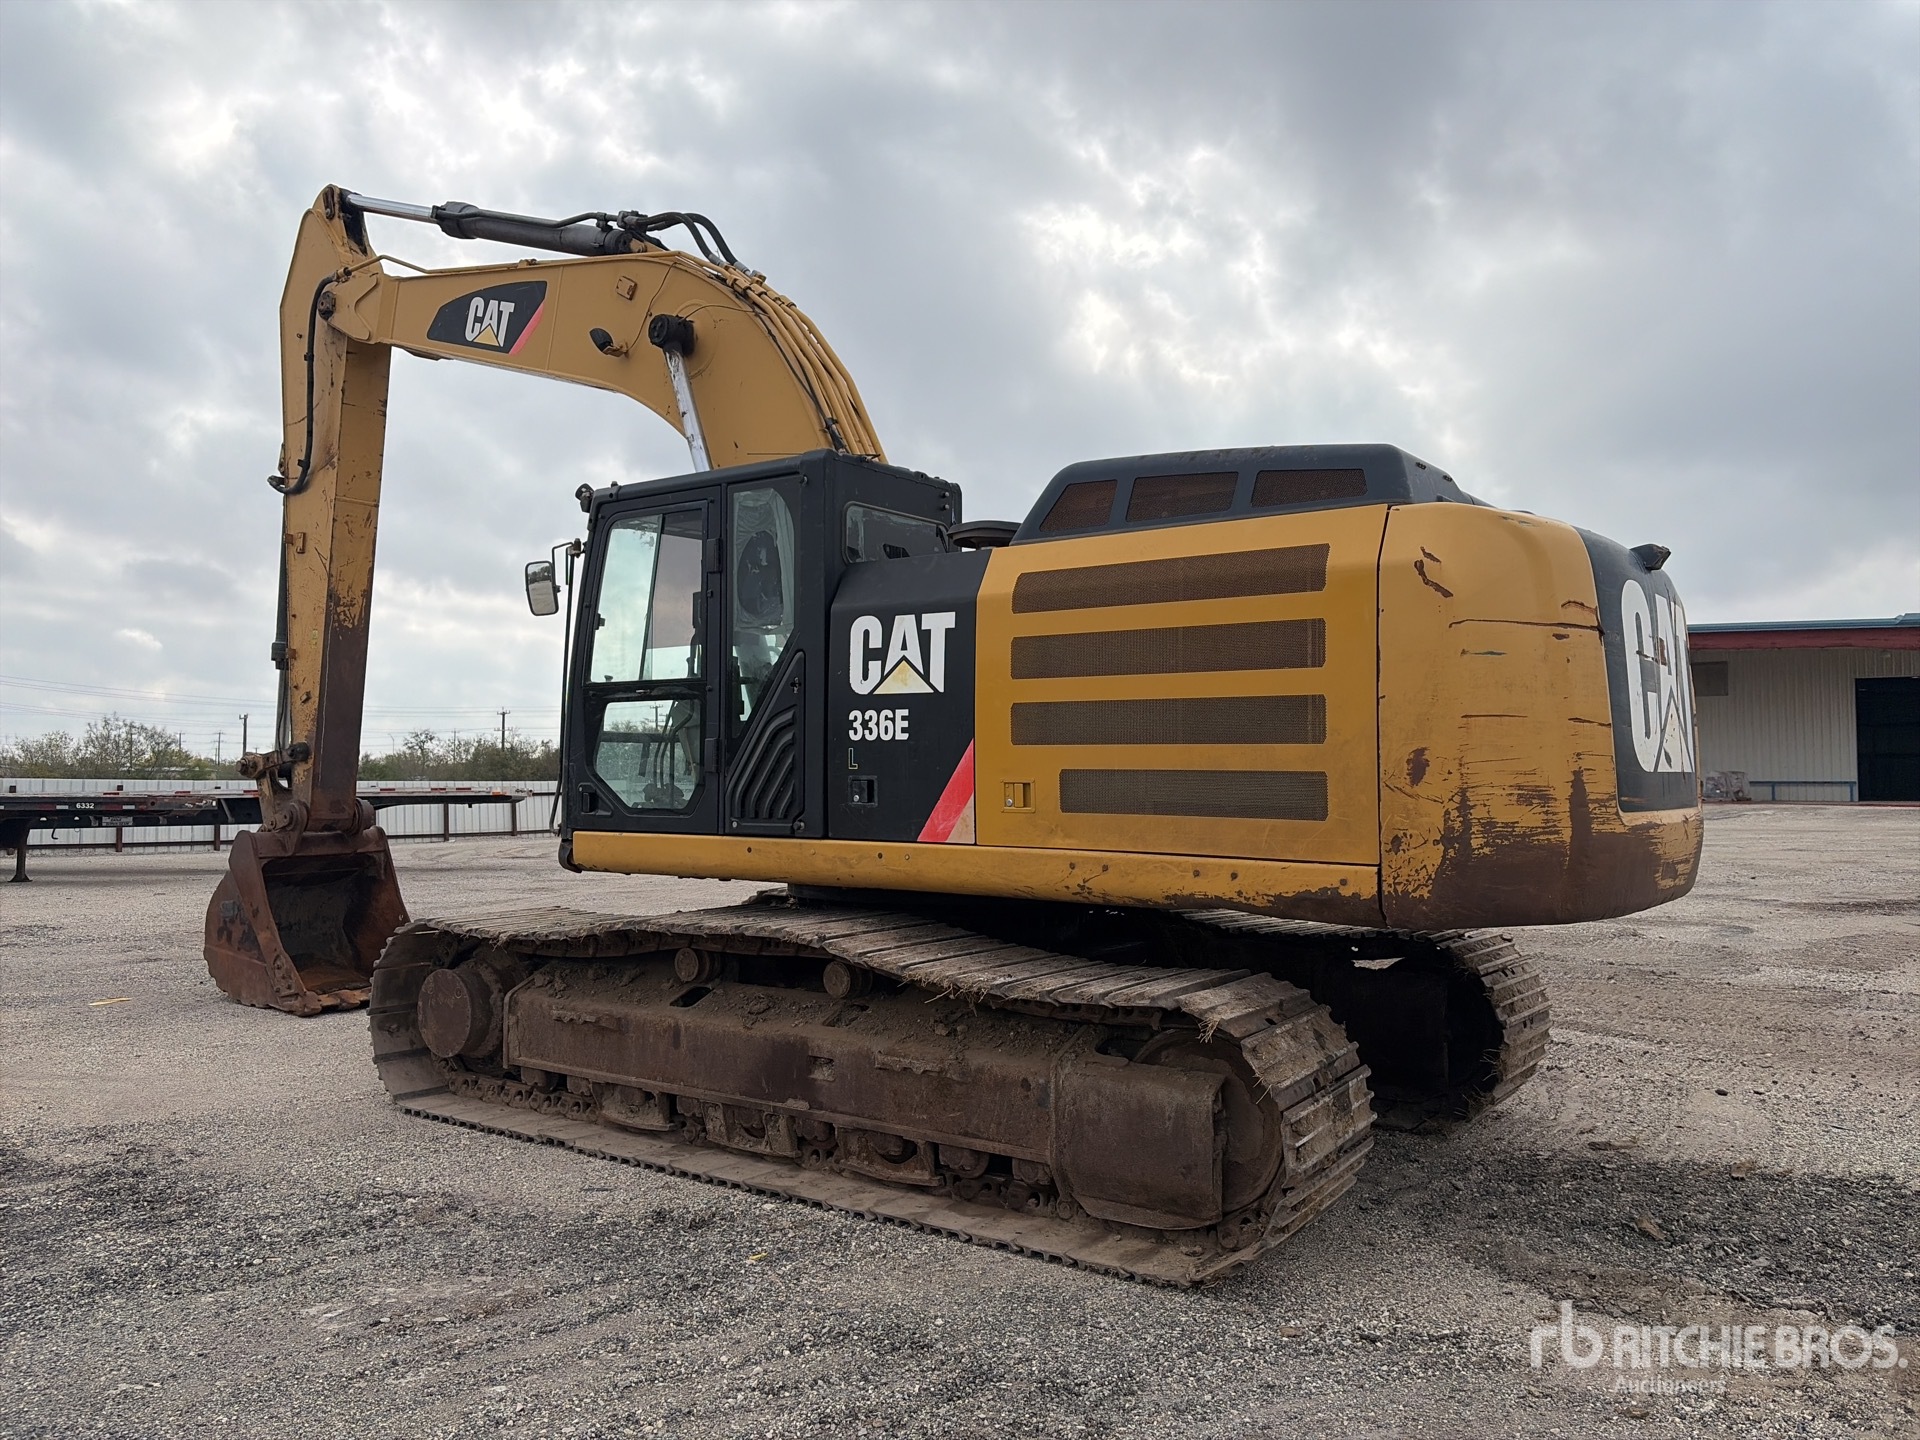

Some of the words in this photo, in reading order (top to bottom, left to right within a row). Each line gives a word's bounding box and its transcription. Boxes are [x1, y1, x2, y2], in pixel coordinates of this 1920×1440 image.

[465, 296, 515, 347] CAT
[849, 611, 956, 695] CAT
[1621, 579, 1695, 773] CAT
[848, 708, 909, 741] 336E
[848, 747, 858, 769] L
